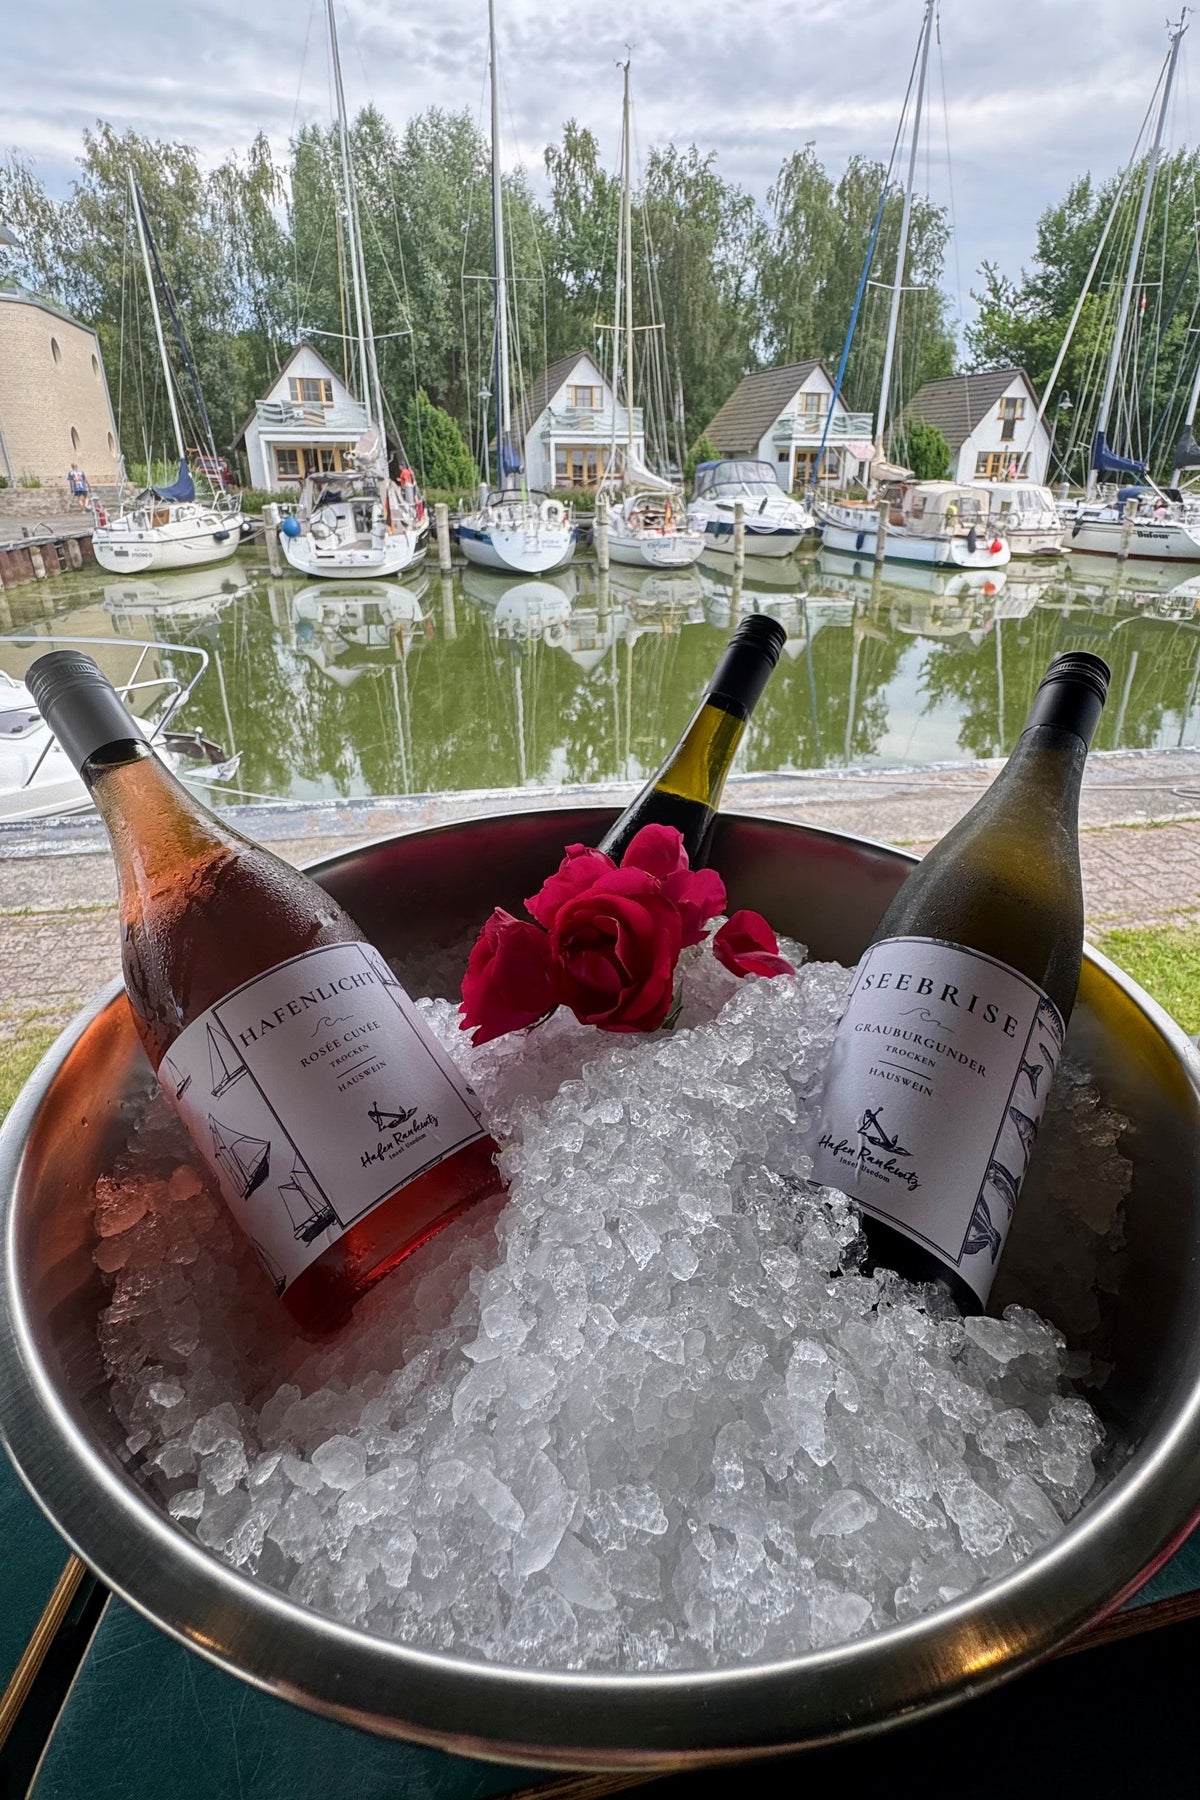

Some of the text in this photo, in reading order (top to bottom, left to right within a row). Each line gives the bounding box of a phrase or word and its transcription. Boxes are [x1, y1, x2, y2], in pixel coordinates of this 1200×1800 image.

[238, 971, 376, 1048] HAFENLICHT
[861, 973, 1019, 1039] SEEBRISE
[299, 1019, 381, 1069] ROSÉE CUVÉE
[329, 1043, 370, 1069] TROCKEN
[854, 1022, 987, 1078] GRAUBURGUNDER
[885, 1044, 937, 1069] TROCKEN
[337, 1060, 388, 1093] HAUSWEIN
[868, 1066, 934, 1097] HAUSWEIN
[360, 1142, 394, 1168] Hafen
[818, 1134, 856, 1157] Hafen
[839, 1157, 891, 1184] Insel Usedom
